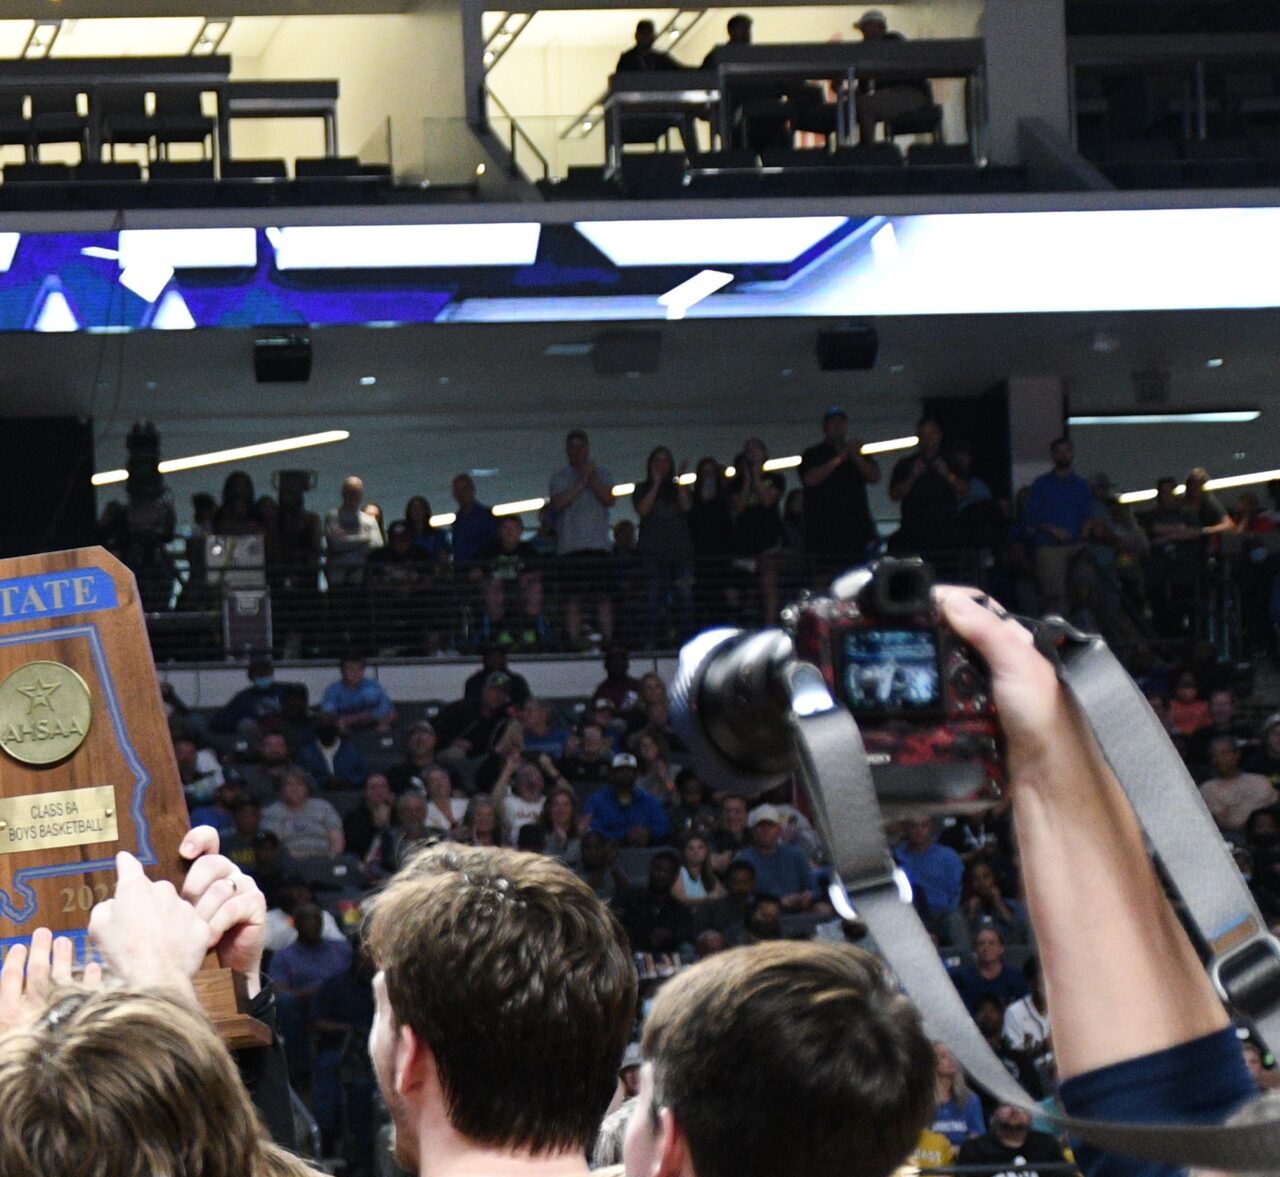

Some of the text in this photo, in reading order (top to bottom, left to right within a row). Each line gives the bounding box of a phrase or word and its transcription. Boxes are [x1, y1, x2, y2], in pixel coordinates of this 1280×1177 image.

[2, 716, 84, 746] AHSAA
[31, 801, 78, 819] CLASS 6A
[8, 818, 103, 842] BOYS BASKETBALL
